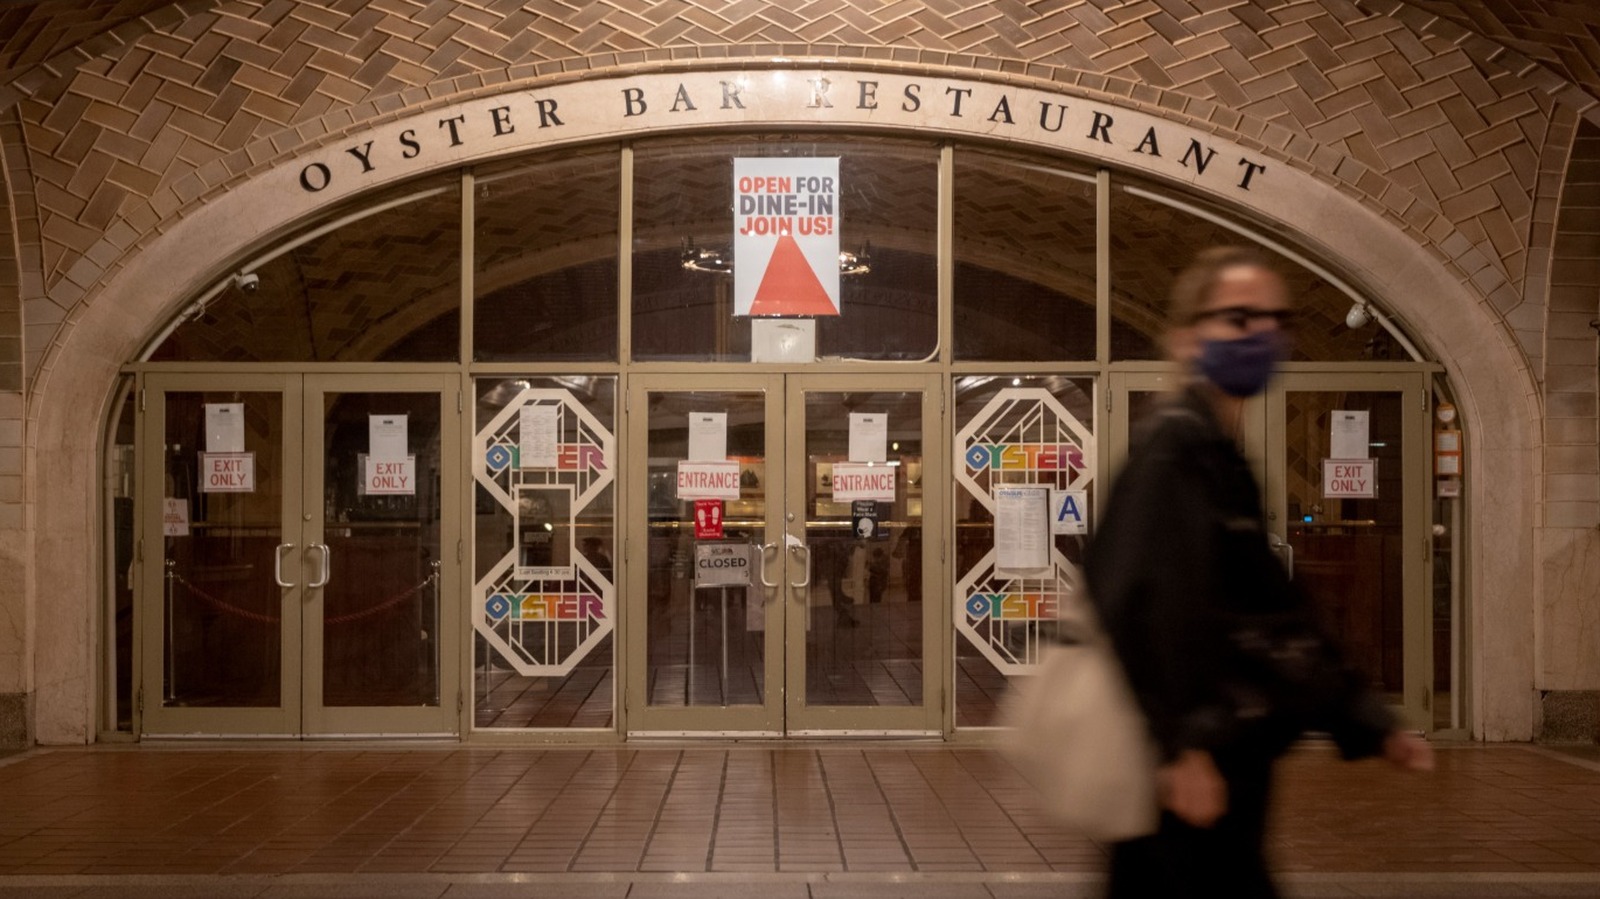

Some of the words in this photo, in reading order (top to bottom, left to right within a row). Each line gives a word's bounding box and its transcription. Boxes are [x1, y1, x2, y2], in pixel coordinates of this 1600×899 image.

[299, 97, 565, 193] OYSTER
[621, 79, 747, 118] BAR
[806, 78, 1266, 192] RESTAURANT
[739, 176, 791, 193] OPEN
[796, 176, 834, 193] FOR
[739, 195, 833, 215] DINE-IN
[739, 216, 793, 236] JOIN
[798, 216, 833, 235] US!
[486, 445, 608, 470] OYER
[966, 444, 1087, 469] OYSTER
[213, 459, 242, 472] EXIT
[376, 463, 404, 475] EXIT
[1335, 466, 1363, 478] EXIT
[210, 473, 246, 486] ONLY
[372, 476, 408, 489] ONLY
[678, 472, 739, 489] ENTRANCE
[833, 474, 894, 491] ENTRANCE
[1331, 480, 1367, 492] ONLY
[1058, 495, 1081, 521] A
[699, 557, 747, 569] CLOSED
[485, 595, 607, 619] OYSTER
[966, 593, 1062, 618] OYSTE
